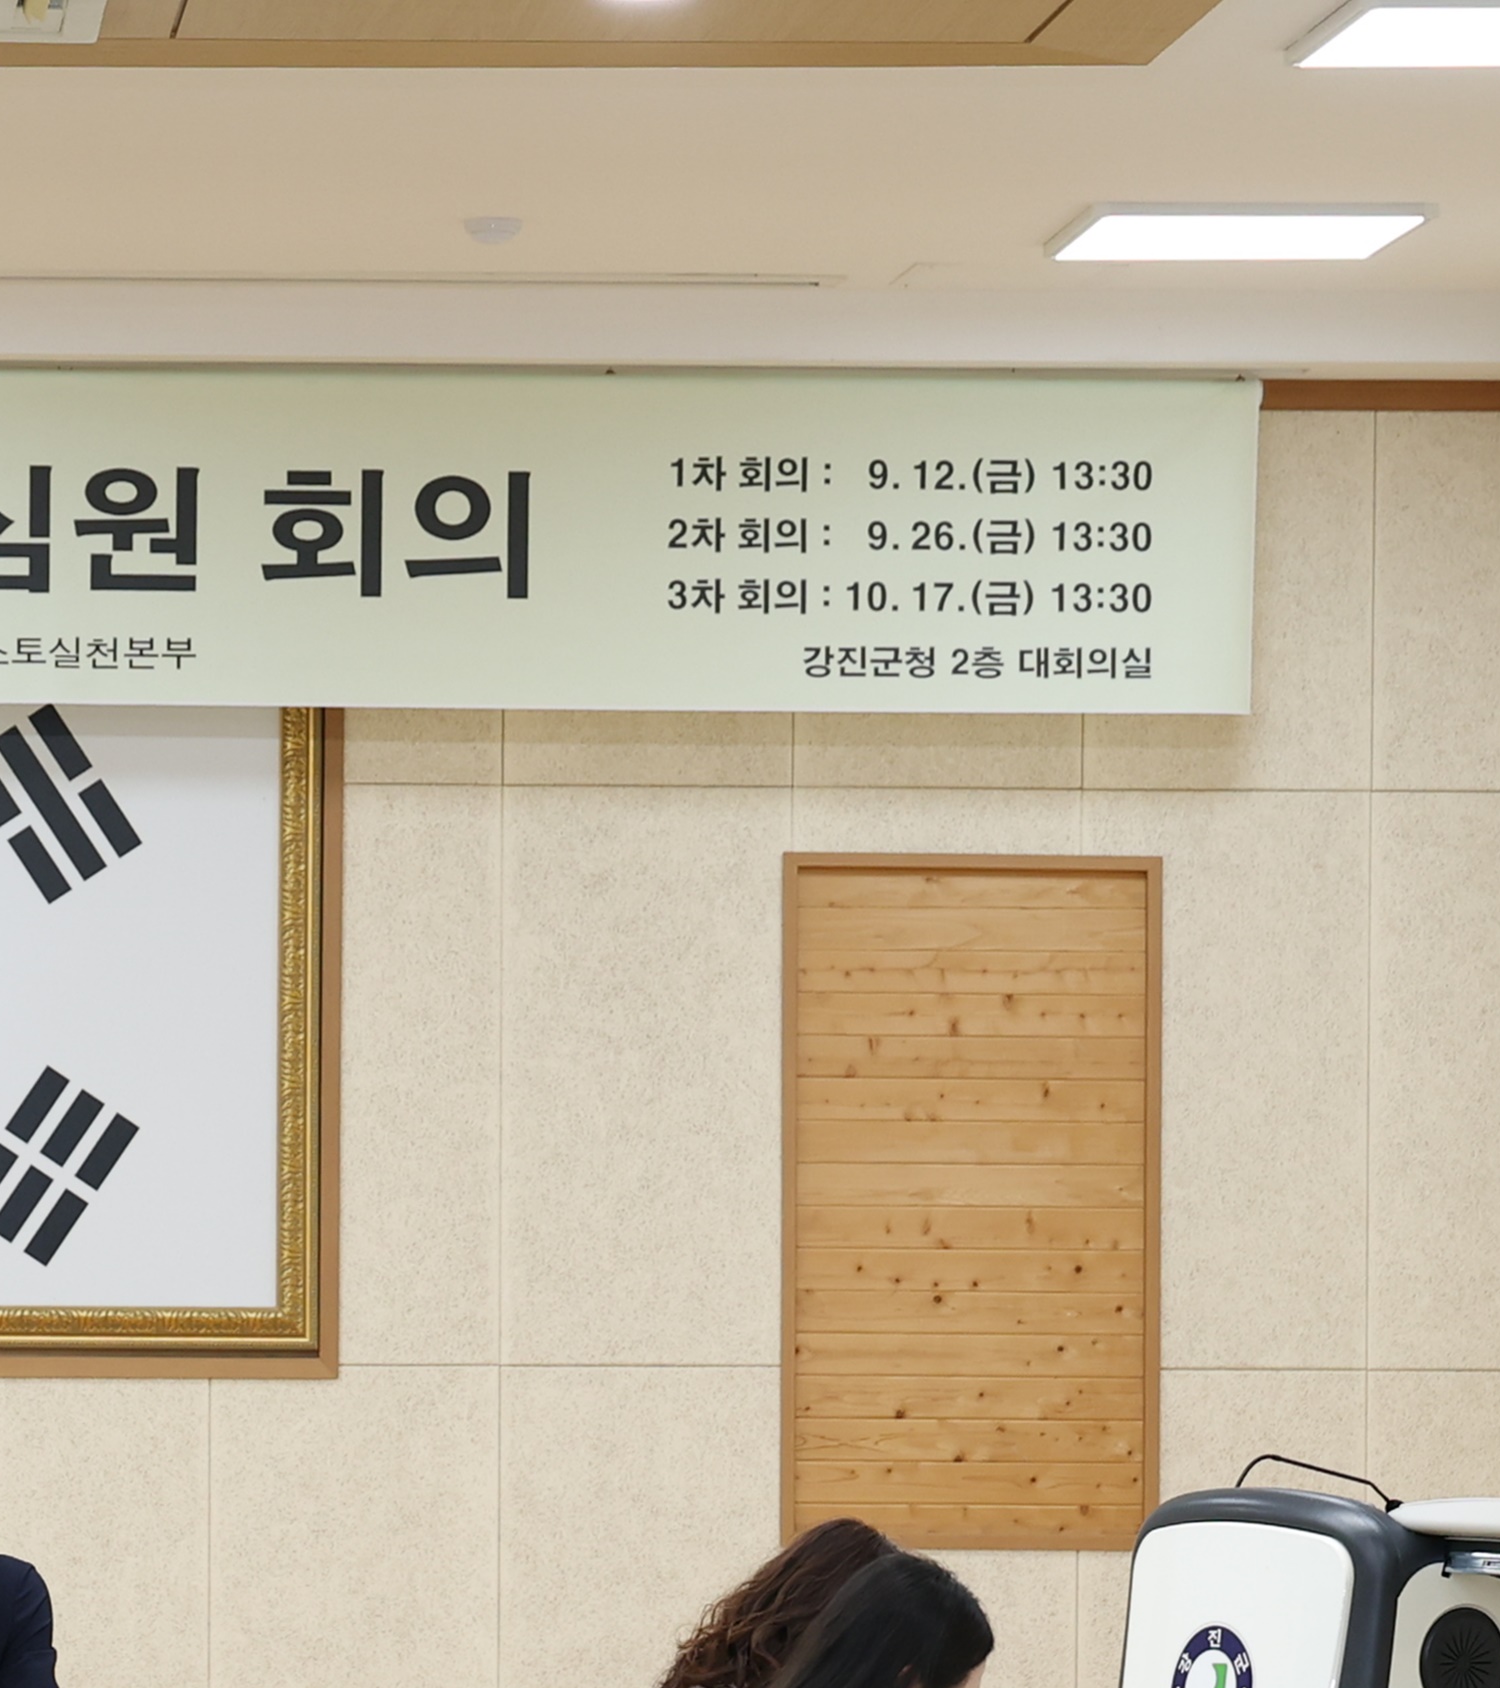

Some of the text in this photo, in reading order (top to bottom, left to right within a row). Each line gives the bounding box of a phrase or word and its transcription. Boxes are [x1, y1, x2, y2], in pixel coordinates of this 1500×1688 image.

[670, 456, 727, 492] 1차
[739, 456, 808, 493] 회의
[1053, 461, 1152, 491] 13:30
[260, 469, 531, 599] 회의
[668, 517, 727, 553] 2차
[738, 517, 807, 553] 회의
[1053, 521, 1152, 552] 13:30
[668, 578, 727, 614] 3차
[738, 579, 807, 615] 회의
[1053, 583, 1152, 613] 13:30
[803, 646, 1152, 680] 강진군청 2층 대회의실
